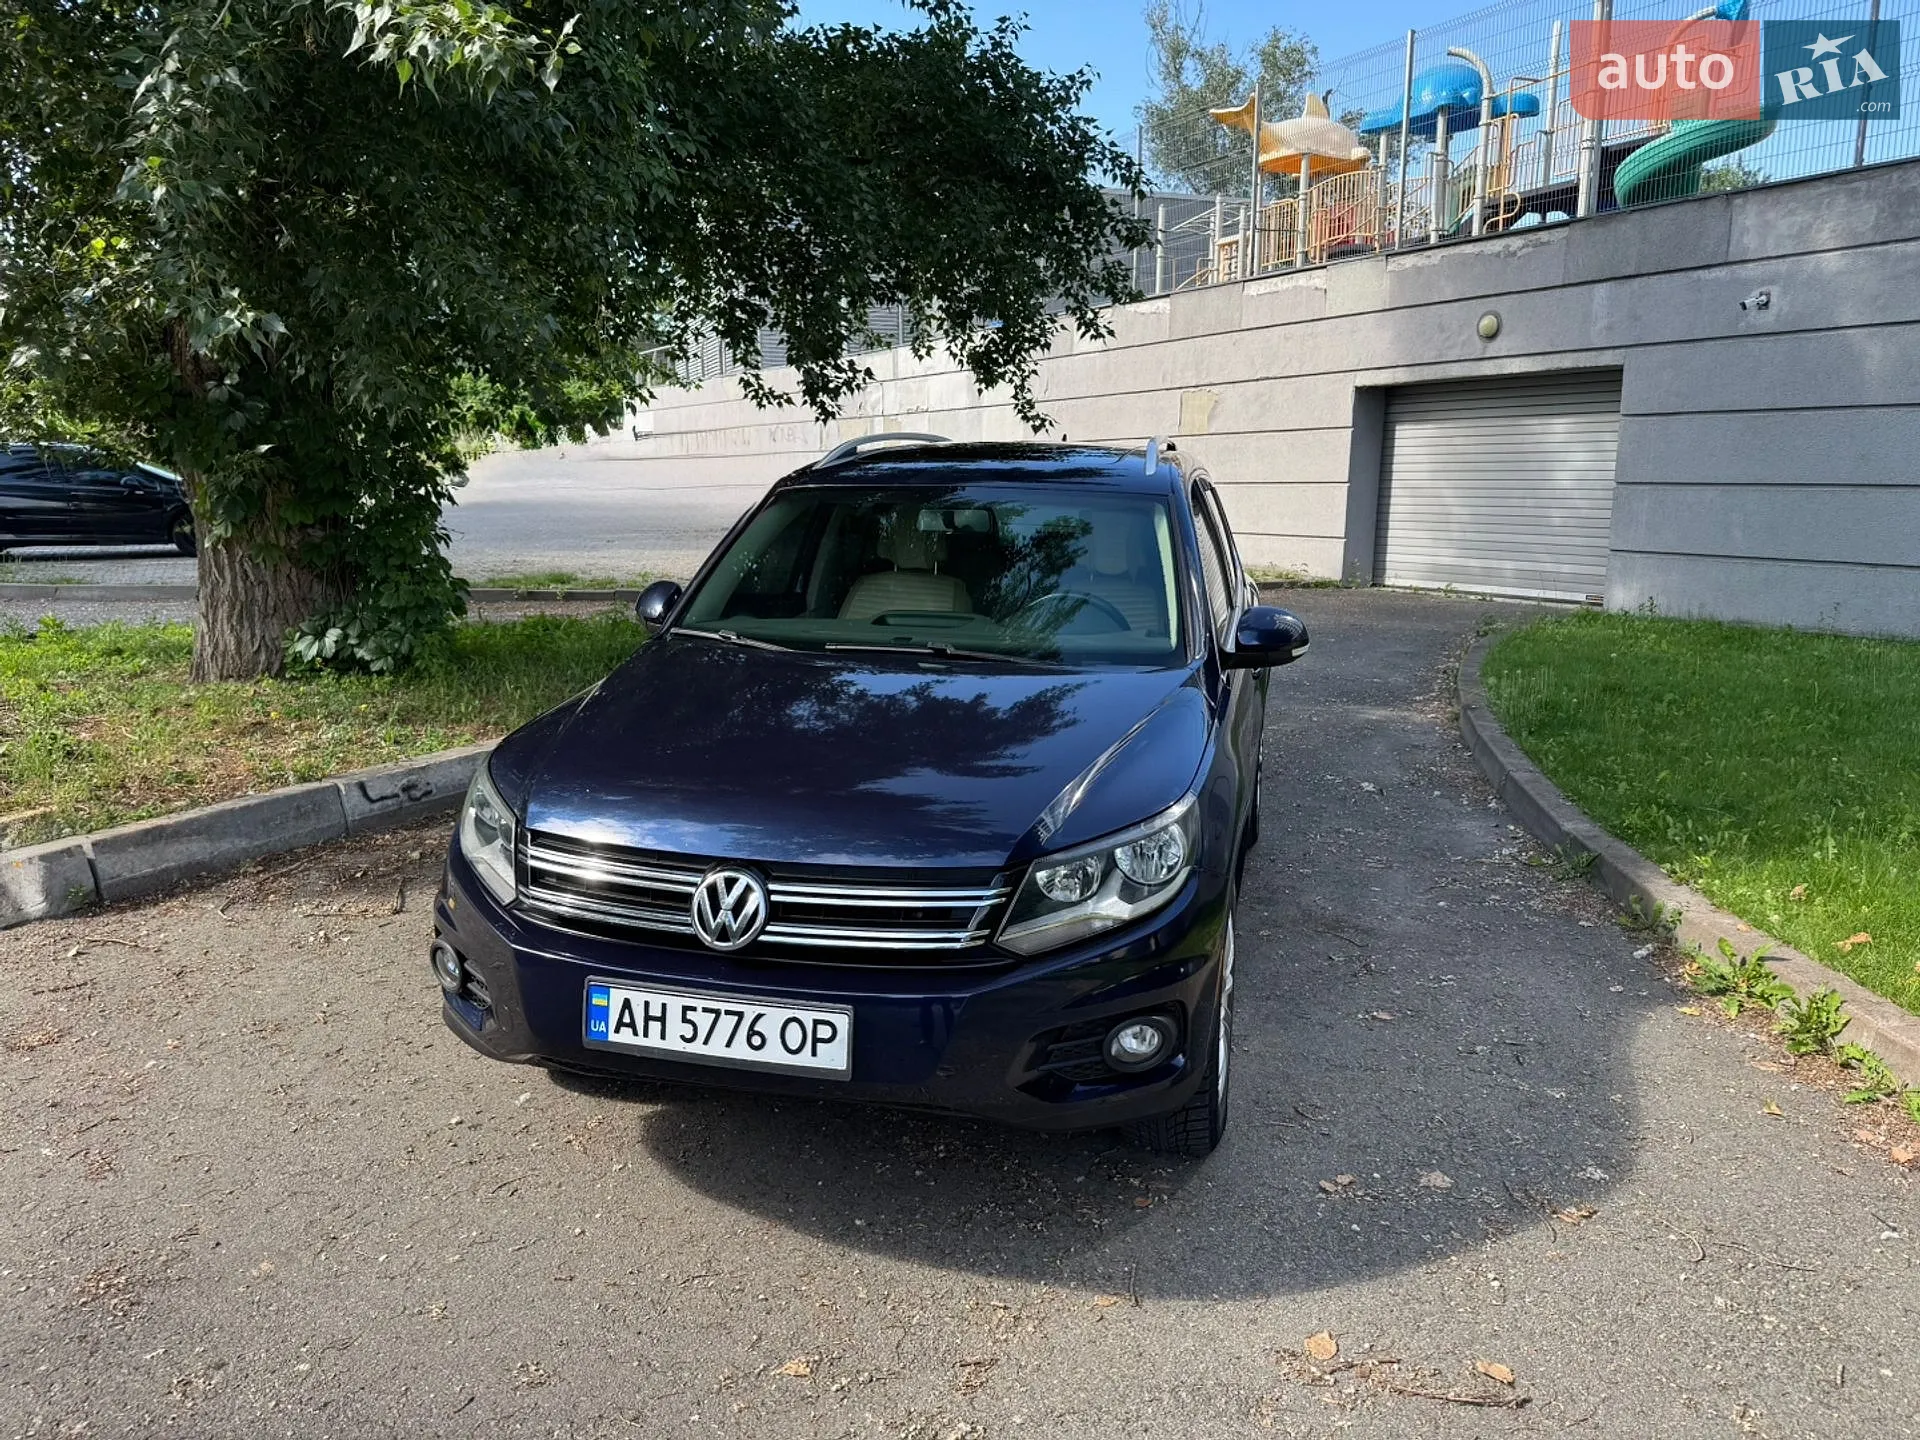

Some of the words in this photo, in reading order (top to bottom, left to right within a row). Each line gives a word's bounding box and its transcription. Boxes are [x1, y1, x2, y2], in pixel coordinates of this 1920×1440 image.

[700, 874, 760, 944] VW
[590, 1019, 607, 1033] UA
[613, 997, 667, 1041] AH
[679, 1005, 767, 1051] 5776
[780, 1016, 838, 1057] OP
